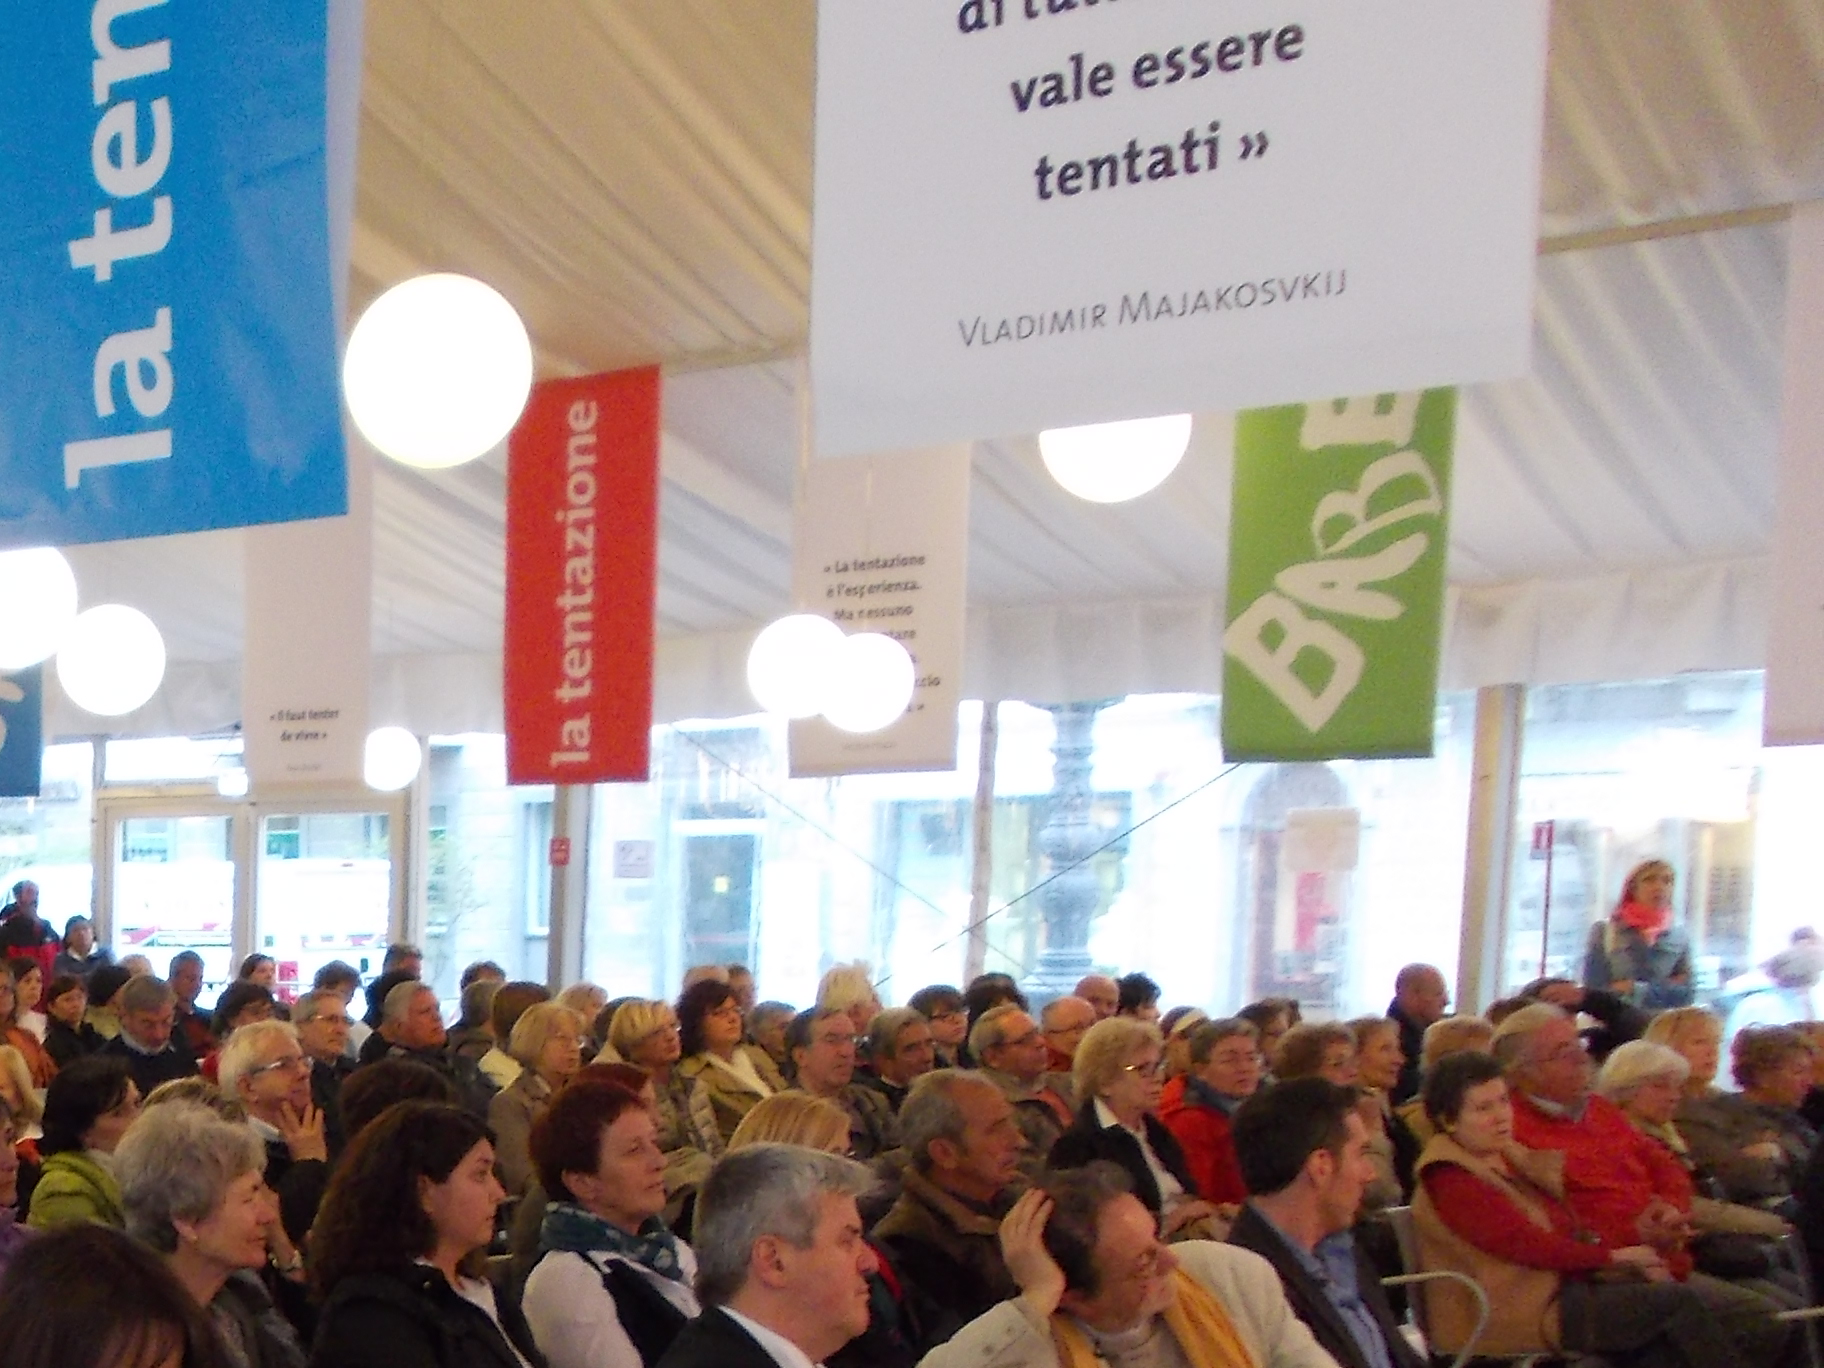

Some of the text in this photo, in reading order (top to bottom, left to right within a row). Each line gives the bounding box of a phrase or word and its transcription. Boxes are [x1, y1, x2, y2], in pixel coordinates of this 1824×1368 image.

[1010, 23, 1307, 114] vale essere
[1034, 121, 1223, 202] tentati
[63, 0, 174, 490] la ten
[957, 302, 1108, 348] VLADIMIR
[550, 398, 601, 769] la tentazione
[852, 553, 926, 572] tentazione
[1223, 388, 1443, 735] BABE
